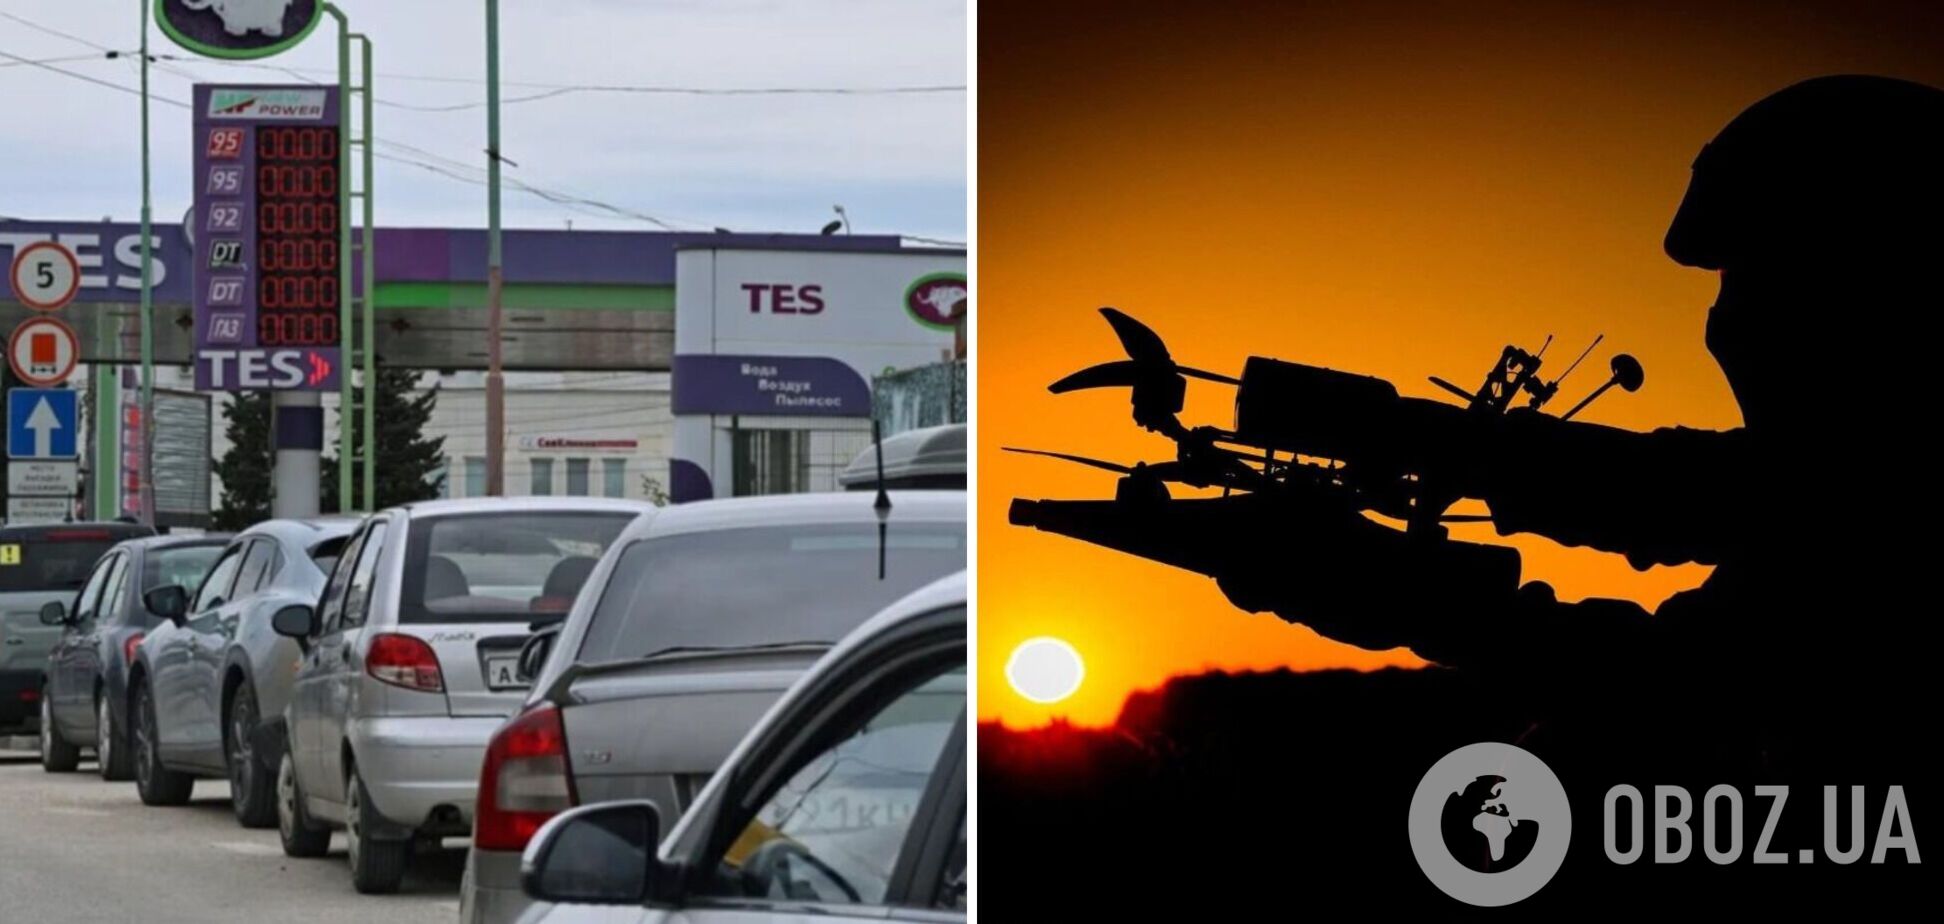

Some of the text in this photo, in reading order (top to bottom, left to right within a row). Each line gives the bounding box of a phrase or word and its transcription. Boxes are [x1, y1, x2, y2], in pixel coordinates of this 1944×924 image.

[258, 104, 320, 115] POWER
[213, 132, 238, 151] 95
[213, 171, 238, 190] 95
[213, 209, 239, 227] 92
[213, 242, 240, 261] DT
[36, 262, 54, 288] 5
[212, 283, 240, 300] DT
[740, 283, 825, 315] TES
[213, 319, 239, 338] ГАЗ
[199, 350, 304, 388] TES
[741, 363, 778, 376] Вода
[758, 378, 811, 394] Воздух
[775, 393, 842, 407] Пылесос
